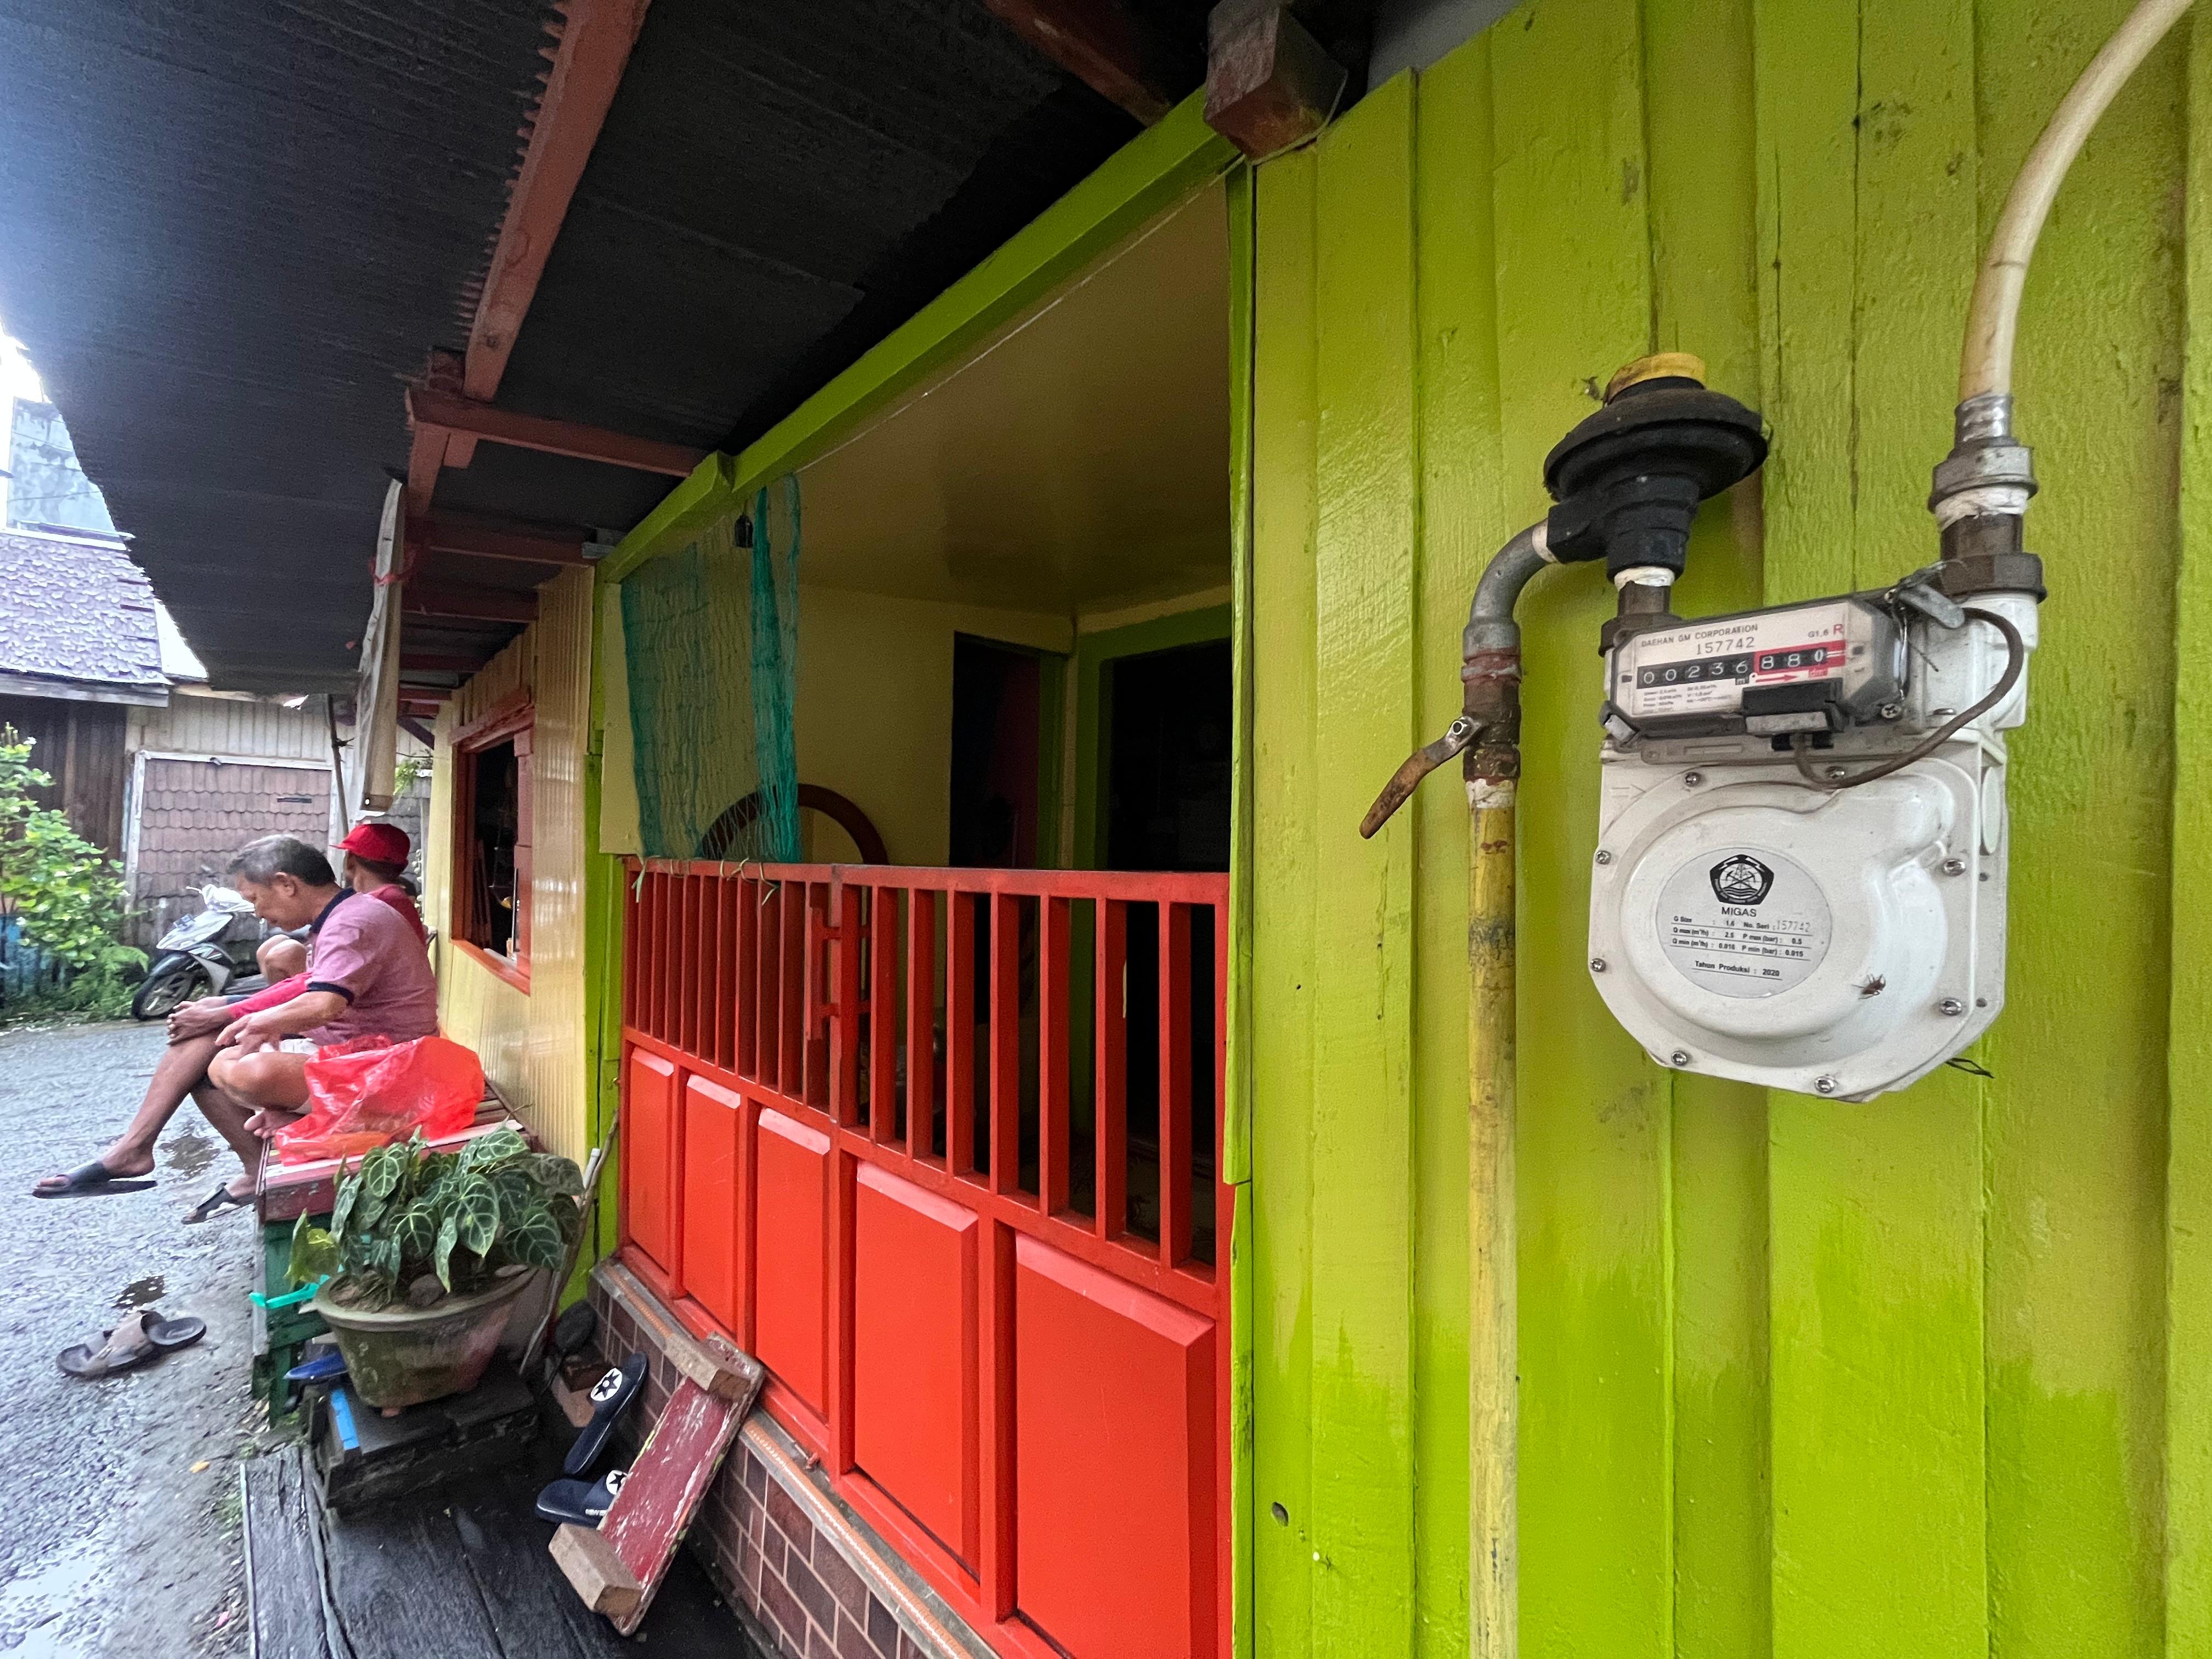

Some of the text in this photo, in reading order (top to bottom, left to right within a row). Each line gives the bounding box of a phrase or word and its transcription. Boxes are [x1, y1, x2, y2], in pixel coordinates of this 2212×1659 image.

[1641, 624, 1758, 647] DAEHAN GM CORPORATION
[1833, 623, 1844, 635] R
[1696, 636, 1755, 655] 157742
[1721, 906, 1757, 917] MIGAS
[1695, 961, 1715, 969] Tahun
[1719, 963, 1750, 973] Produksi
[1762, 968, 1780, 977] 2020
